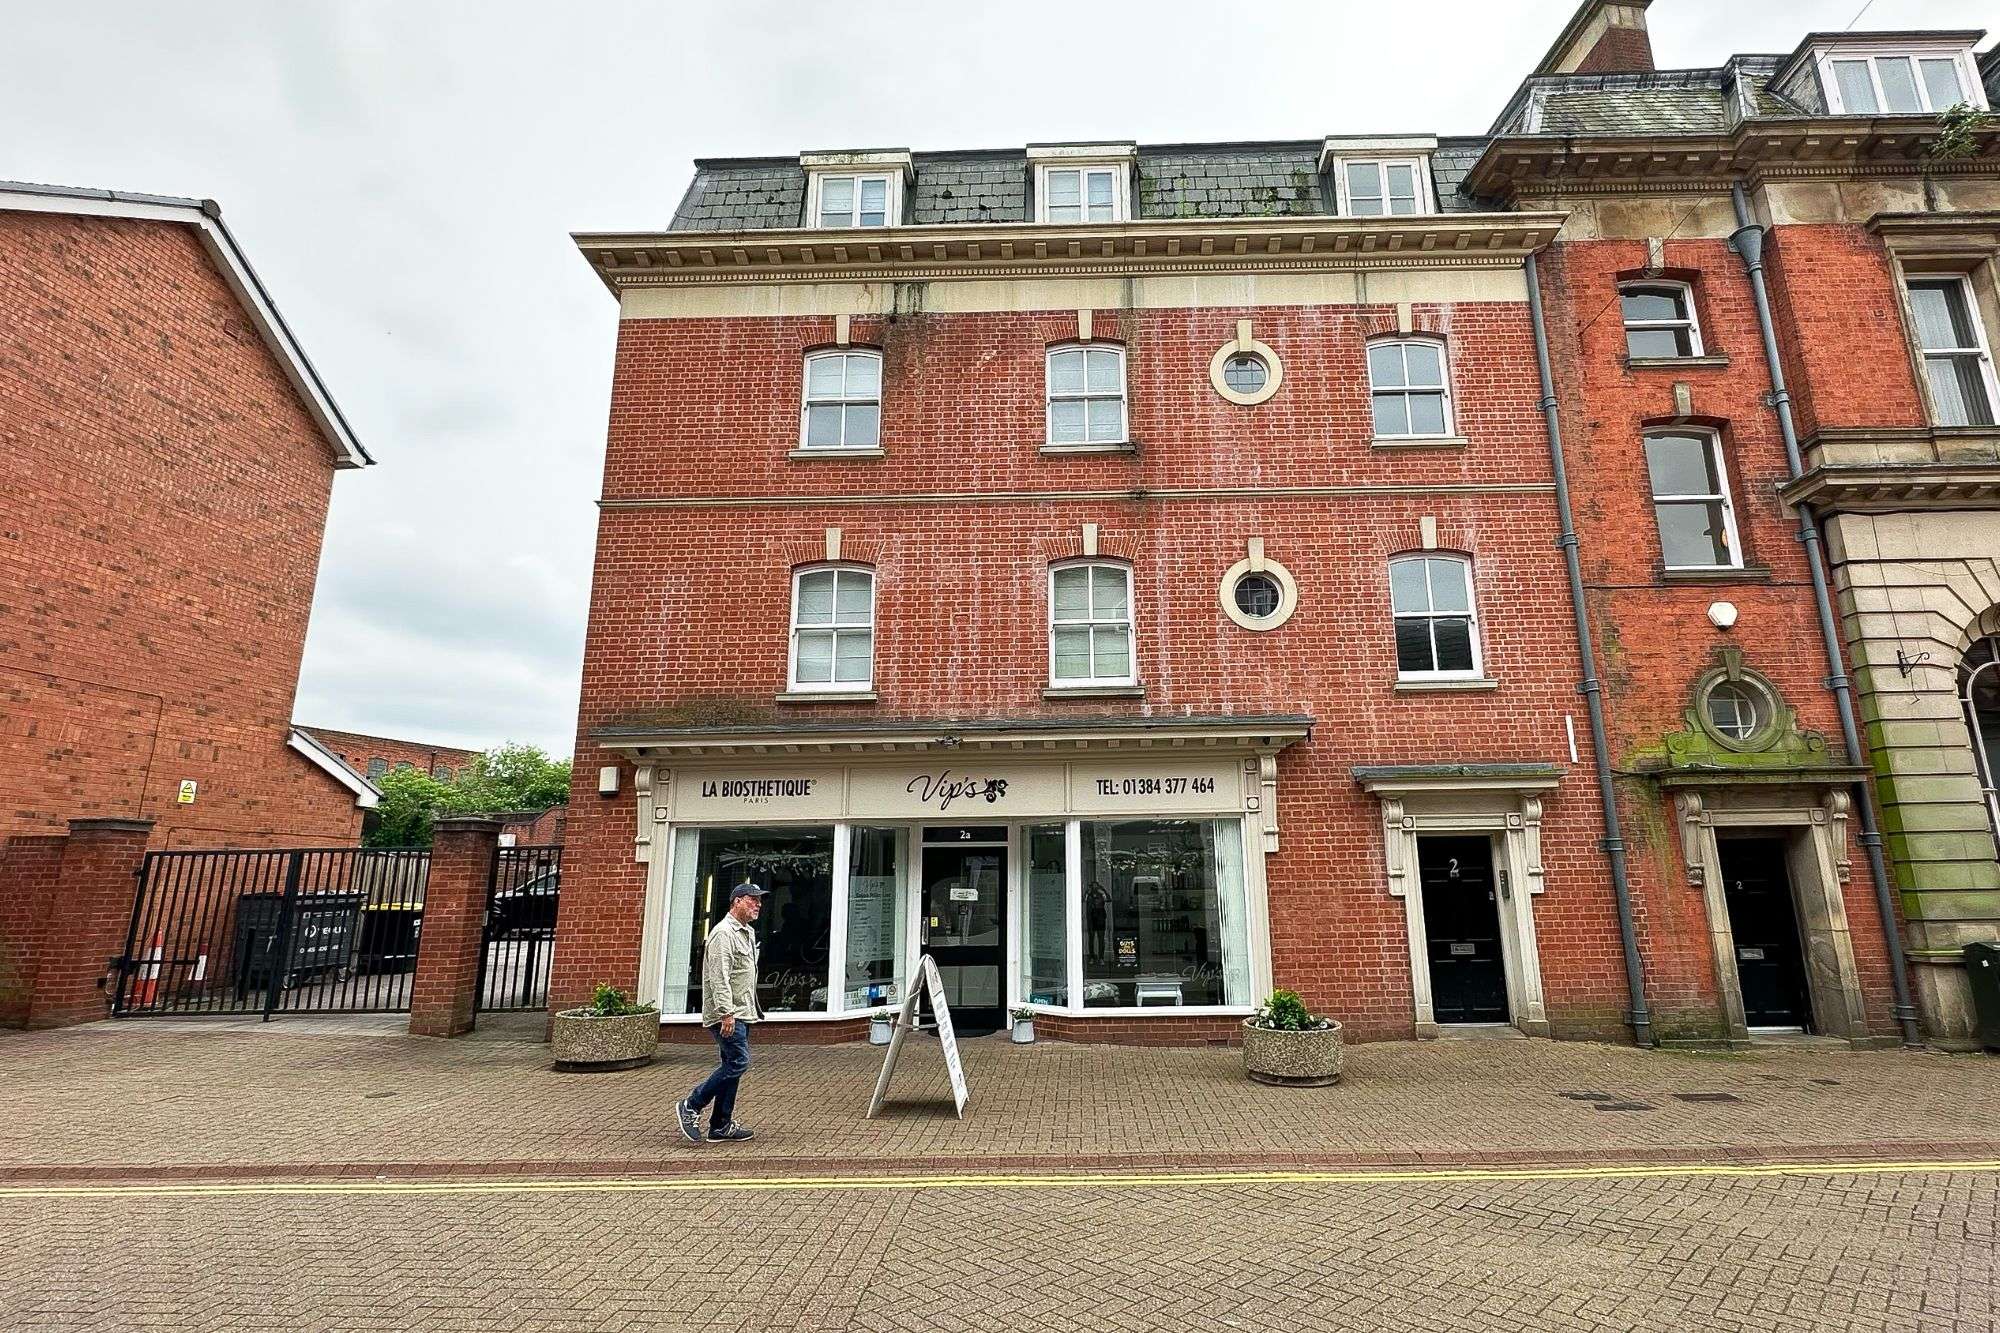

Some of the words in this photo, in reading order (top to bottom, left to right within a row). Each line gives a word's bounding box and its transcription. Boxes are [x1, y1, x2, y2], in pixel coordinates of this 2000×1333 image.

[701, 780, 718, 798] LA
[721, 779, 811, 797] BIOSTHETIQUE
[906, 769, 977, 811] Vip's
[1096, 779, 1119, 795] TEL:
[1122, 778, 1161, 795] 01384
[1164, 777, 1187, 794] 377
[1191, 777, 1214, 794] 464
[960, 830, 971, 839] 2a
[1449, 858, 1460, 873] 2
[1736, 880, 1744, 890] 2
